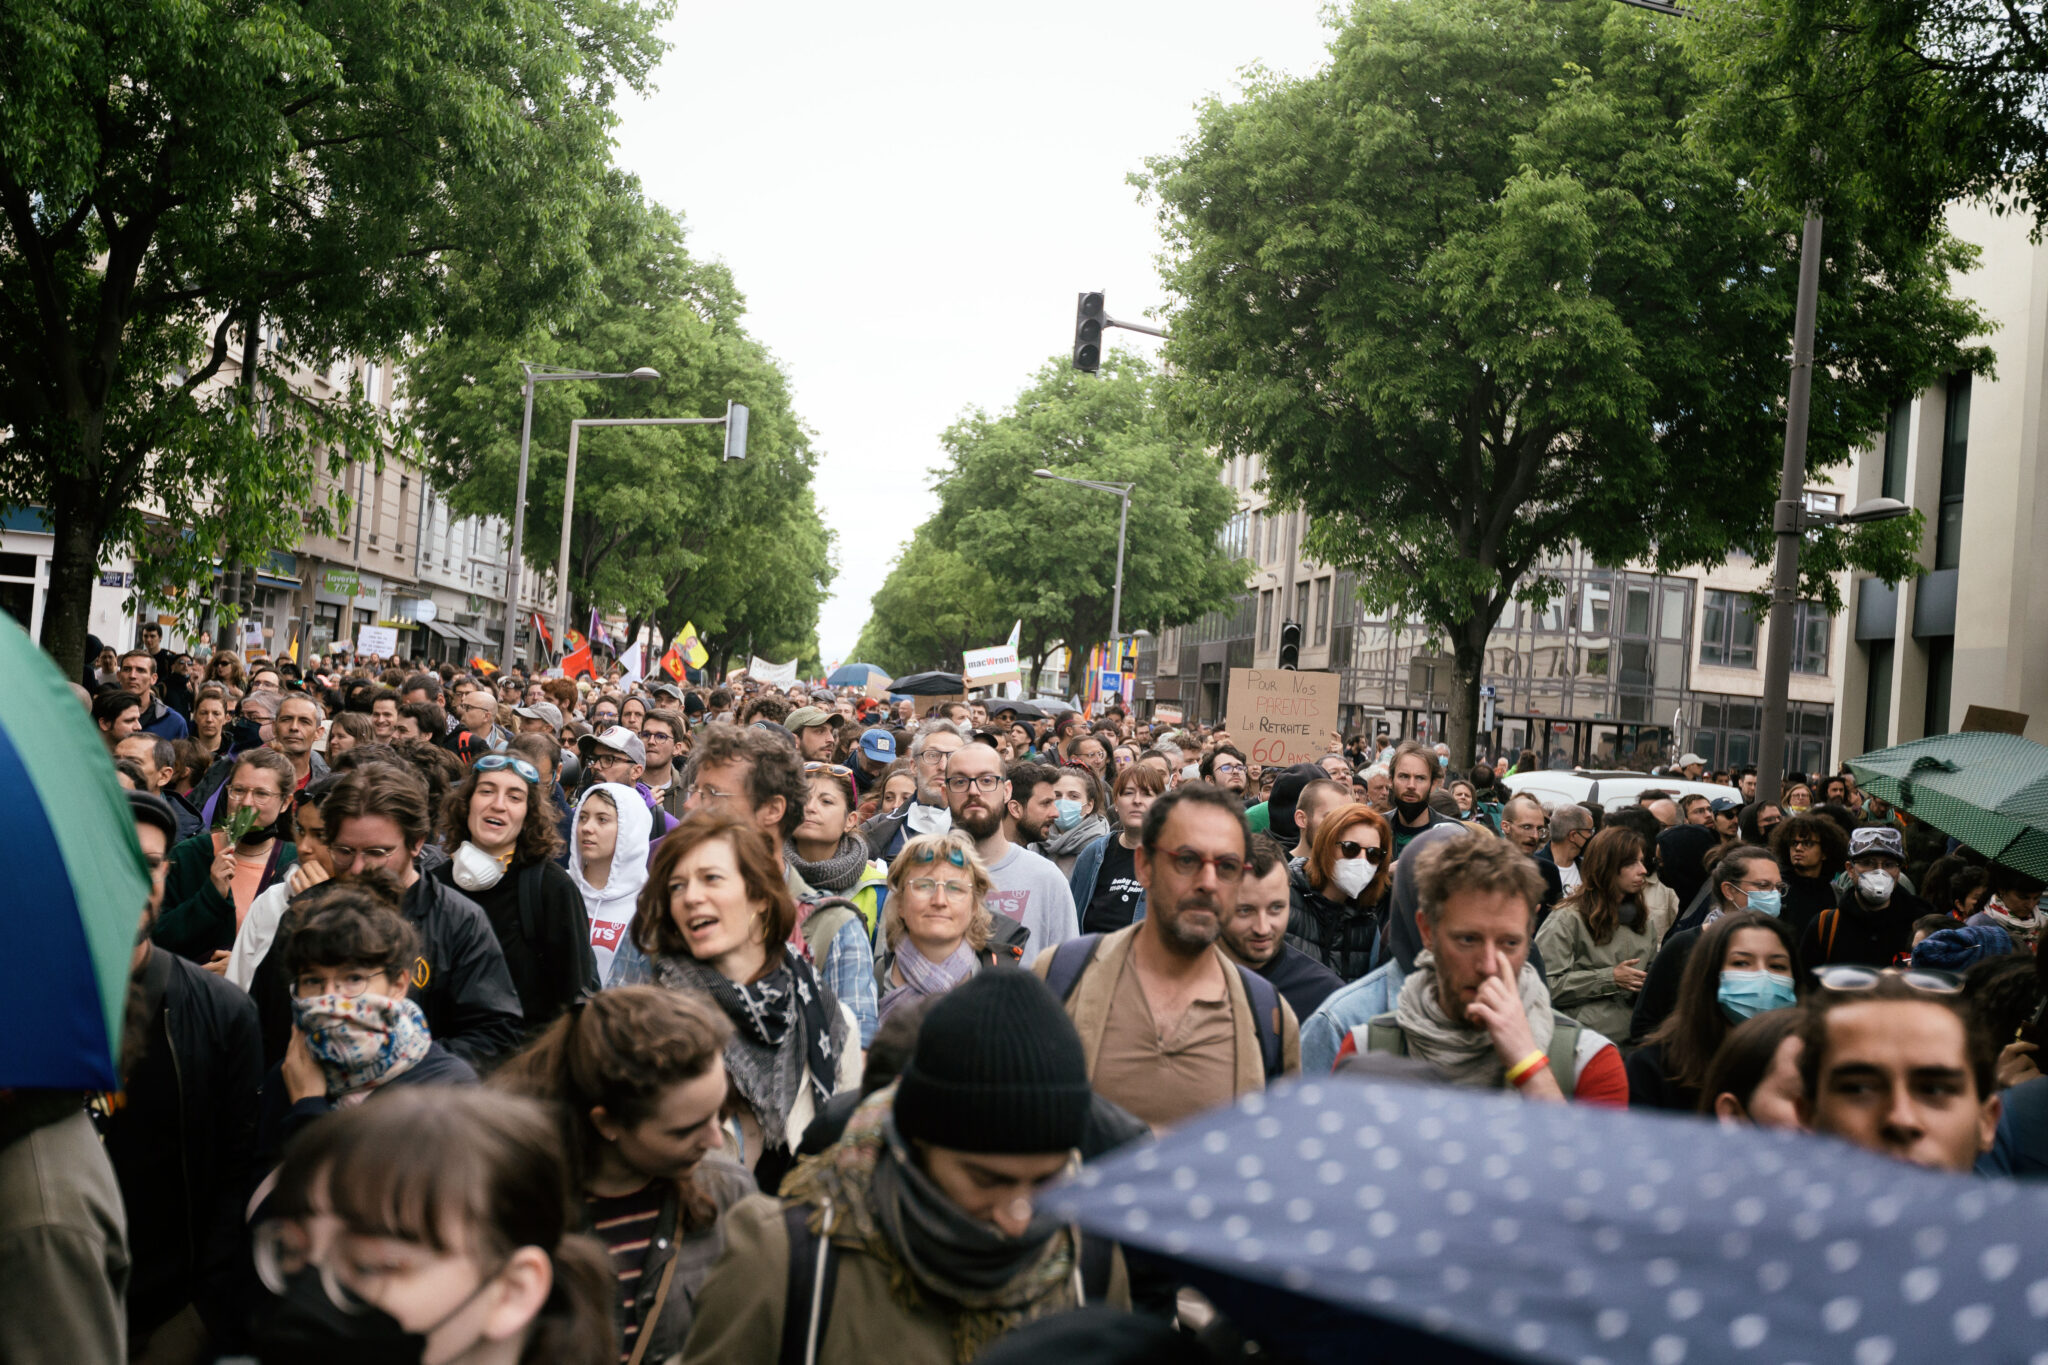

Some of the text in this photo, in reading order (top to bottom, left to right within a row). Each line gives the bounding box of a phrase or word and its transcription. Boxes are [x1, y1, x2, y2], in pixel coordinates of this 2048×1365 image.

[334, 583, 349, 592] 7/7
[1257, 696, 1320, 717] PARENTS
[1260, 716, 1311, 735] RETRAITE
[1252, 738, 1311, 764] 60 ANS
[1111, 877, 1132, 886] baby
